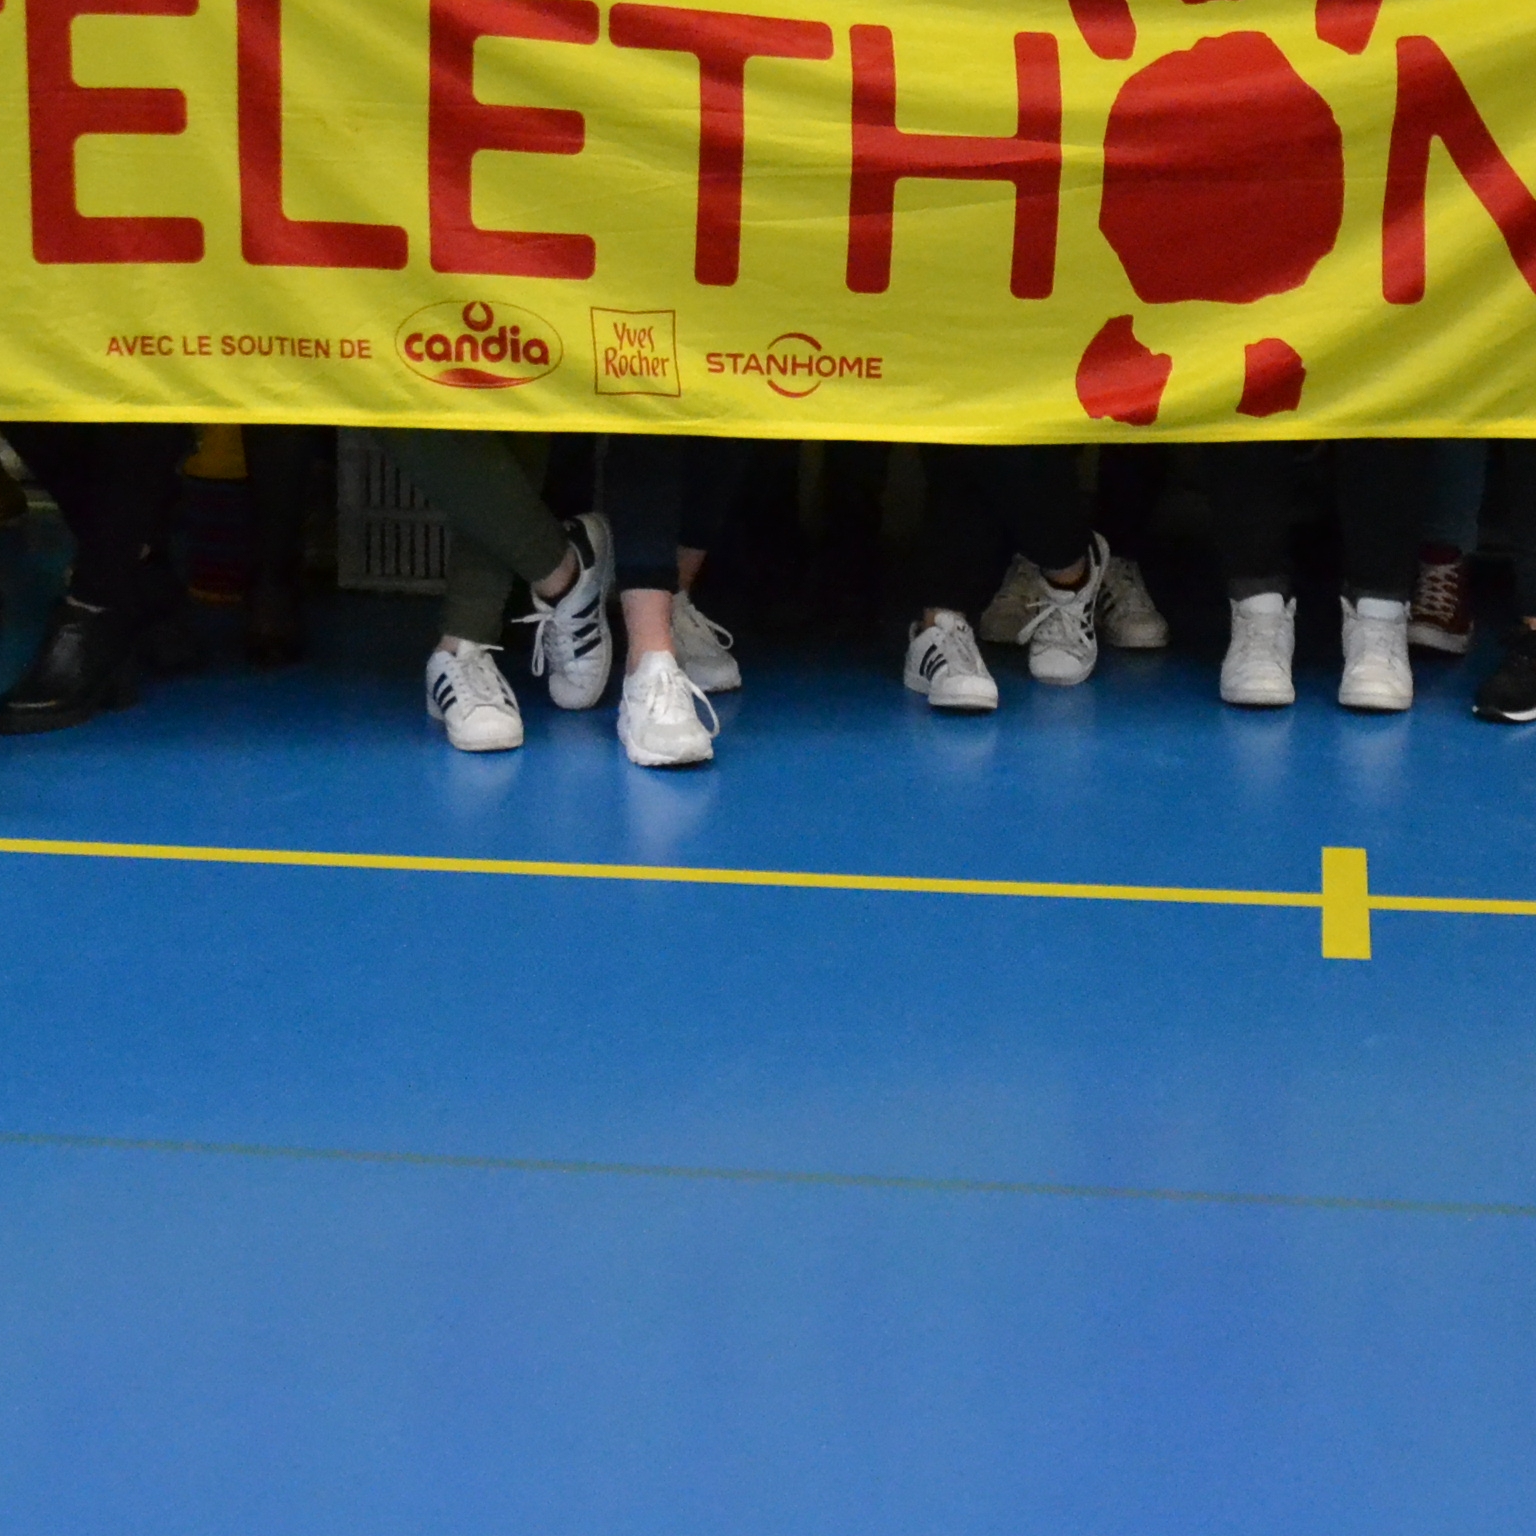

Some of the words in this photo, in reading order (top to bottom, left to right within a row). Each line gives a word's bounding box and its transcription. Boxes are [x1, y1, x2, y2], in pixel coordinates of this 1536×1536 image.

[106, 336, 174, 357] AVEC
[182, 336, 212, 356] LE
[221, 336, 331, 359] SOUTIEN
[340, 339, 373, 359] DE
[404, 325, 550, 365] candia
[613, 322, 655, 352] Yves
[604, 347, 670, 379] Rocher
[706, 352, 883, 379] STANHOME
